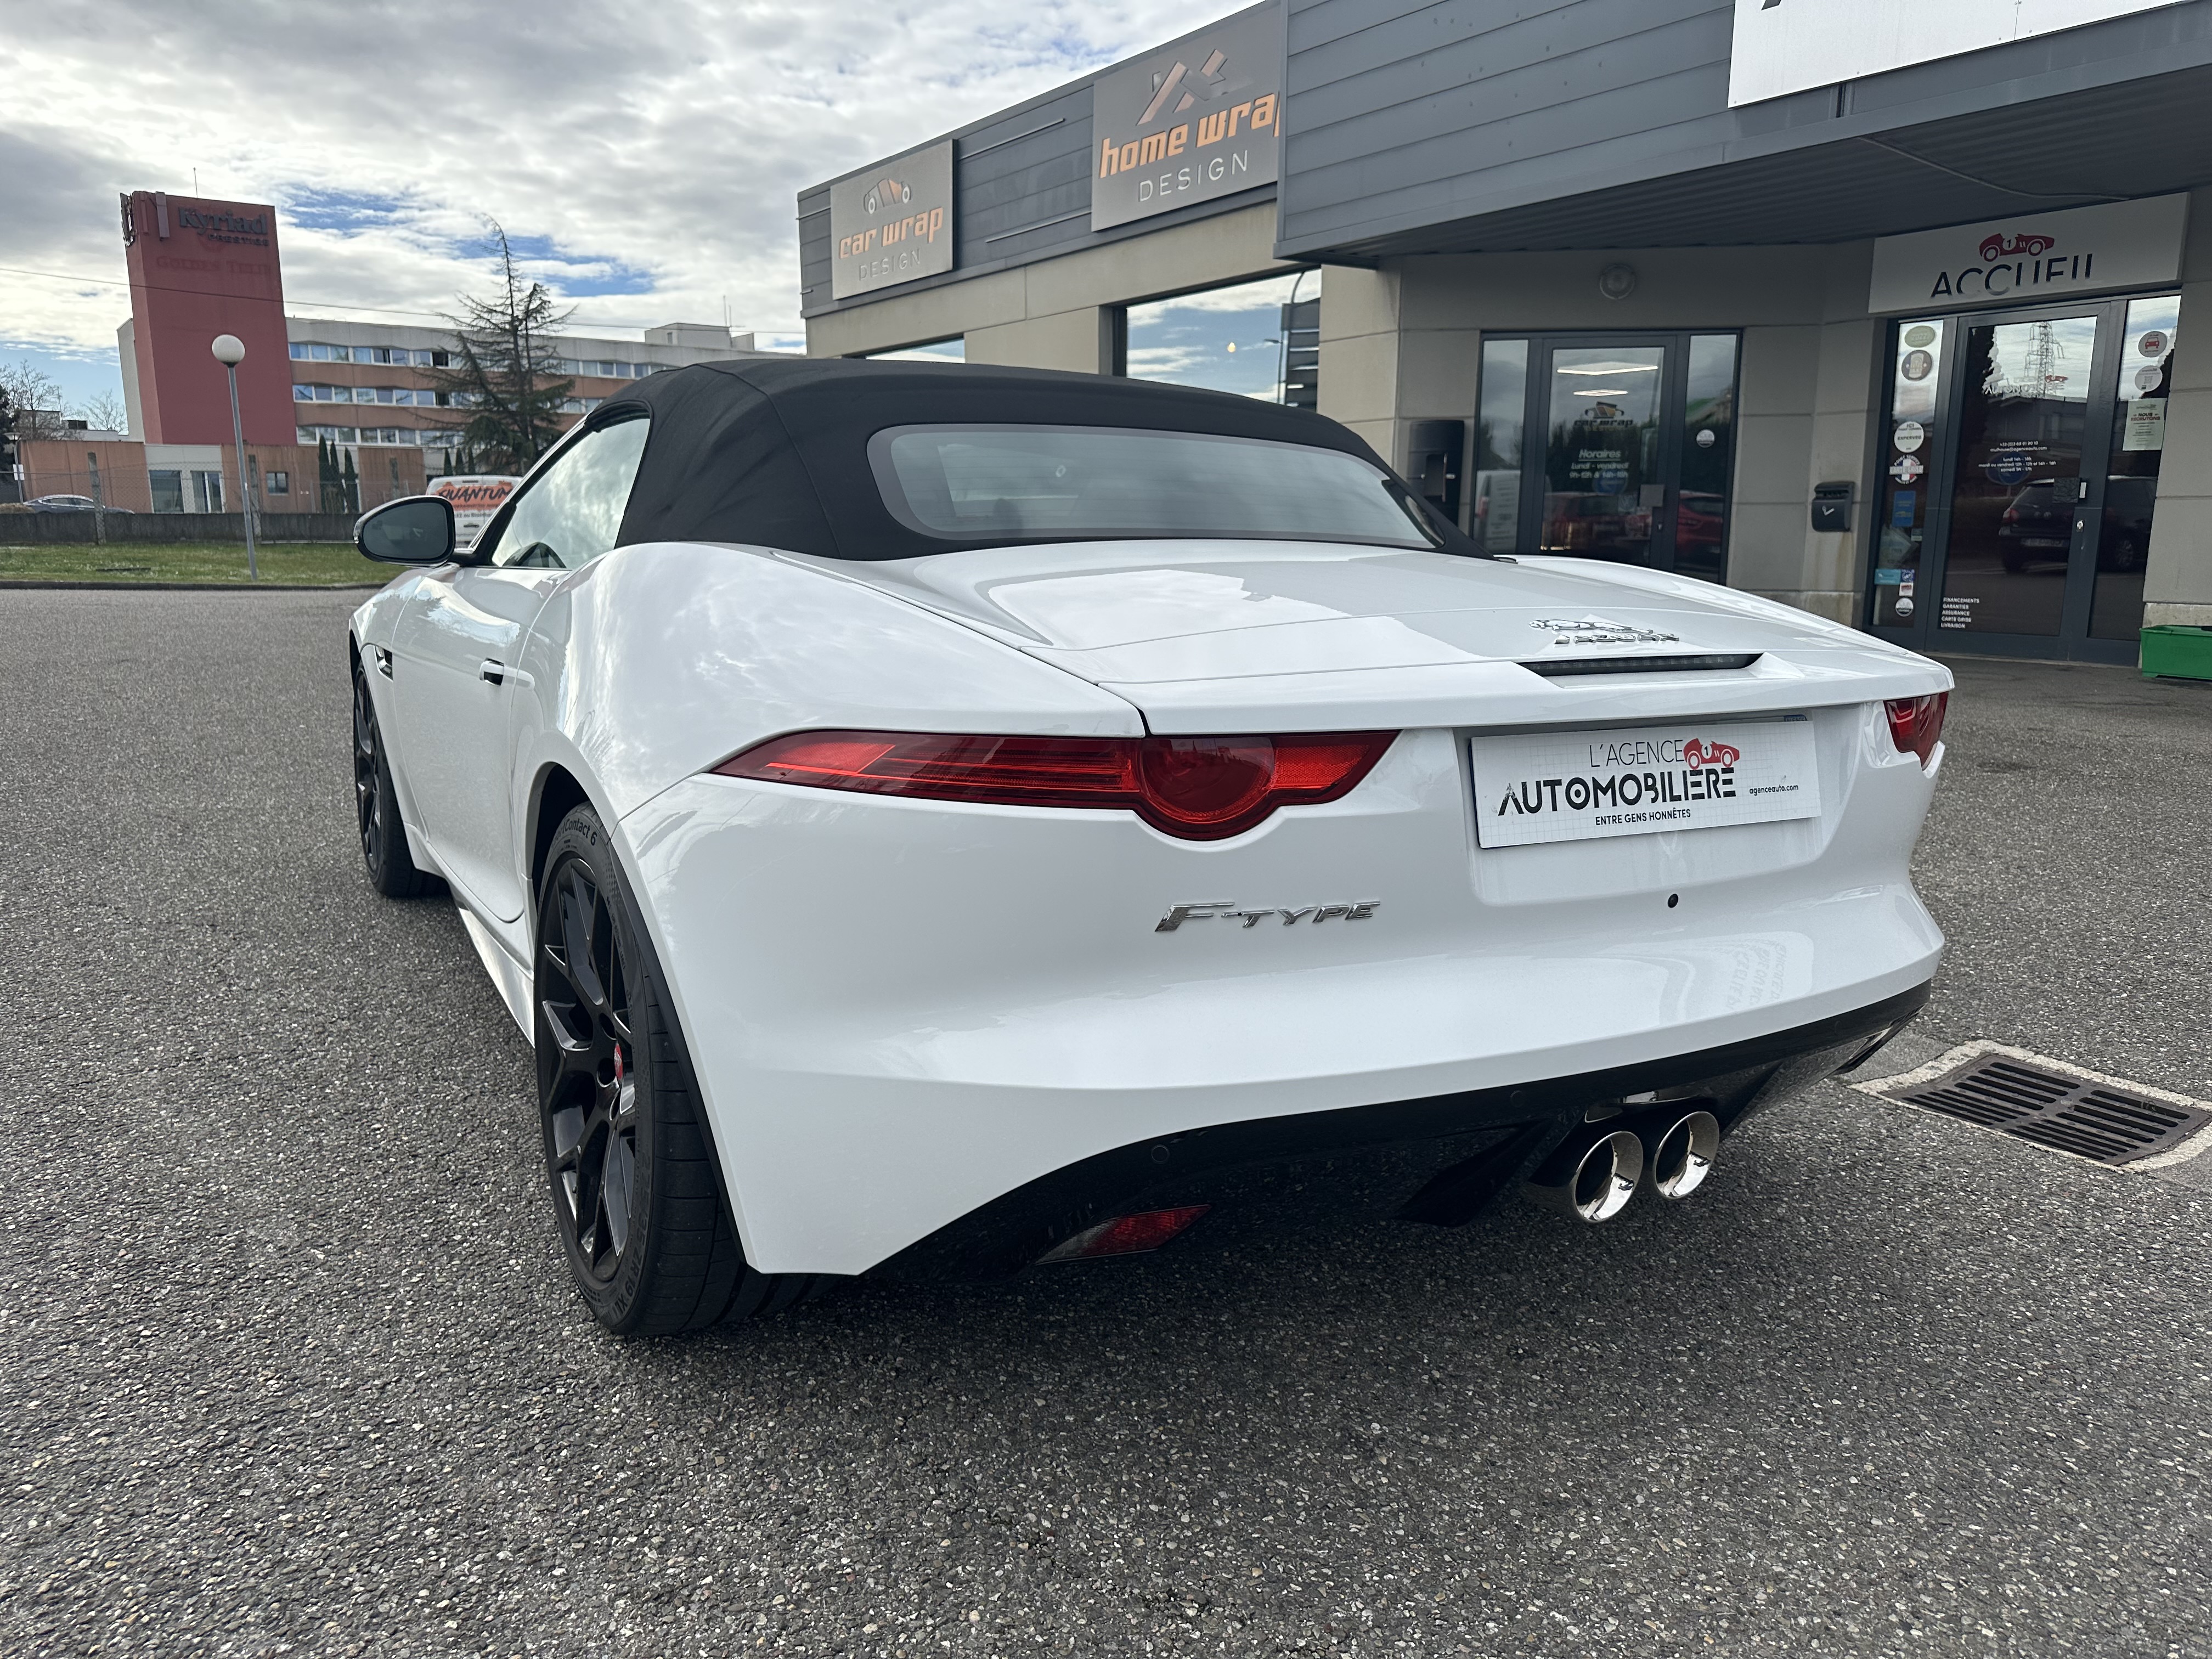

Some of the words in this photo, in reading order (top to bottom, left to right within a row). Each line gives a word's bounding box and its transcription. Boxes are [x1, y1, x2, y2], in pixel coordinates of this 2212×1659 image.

[1099, 123, 1189, 178] home
[1138, 150, 1248, 202] DESIGN
[178, 206, 268, 235] Kyriad
[839, 228, 877, 259] car
[882, 206, 943, 247] wrap
[208, 233, 269, 246] PRESTIGE
[859, 248, 921, 281] DESIGN
[1578, 448, 1622, 458] Horaires
[1589, 739, 1685, 768] L'AGENCE
[1749, 785, 1799, 797] agenceauto.com
[1595, 814, 1622, 826] ENTRE
[1624, 812, 1647, 823] GENS
[1649, 808, 1691, 822] HONNÊTES
[590, 831, 597, 846] 6
[1154, 901, 1381, 933] F-TYPE
